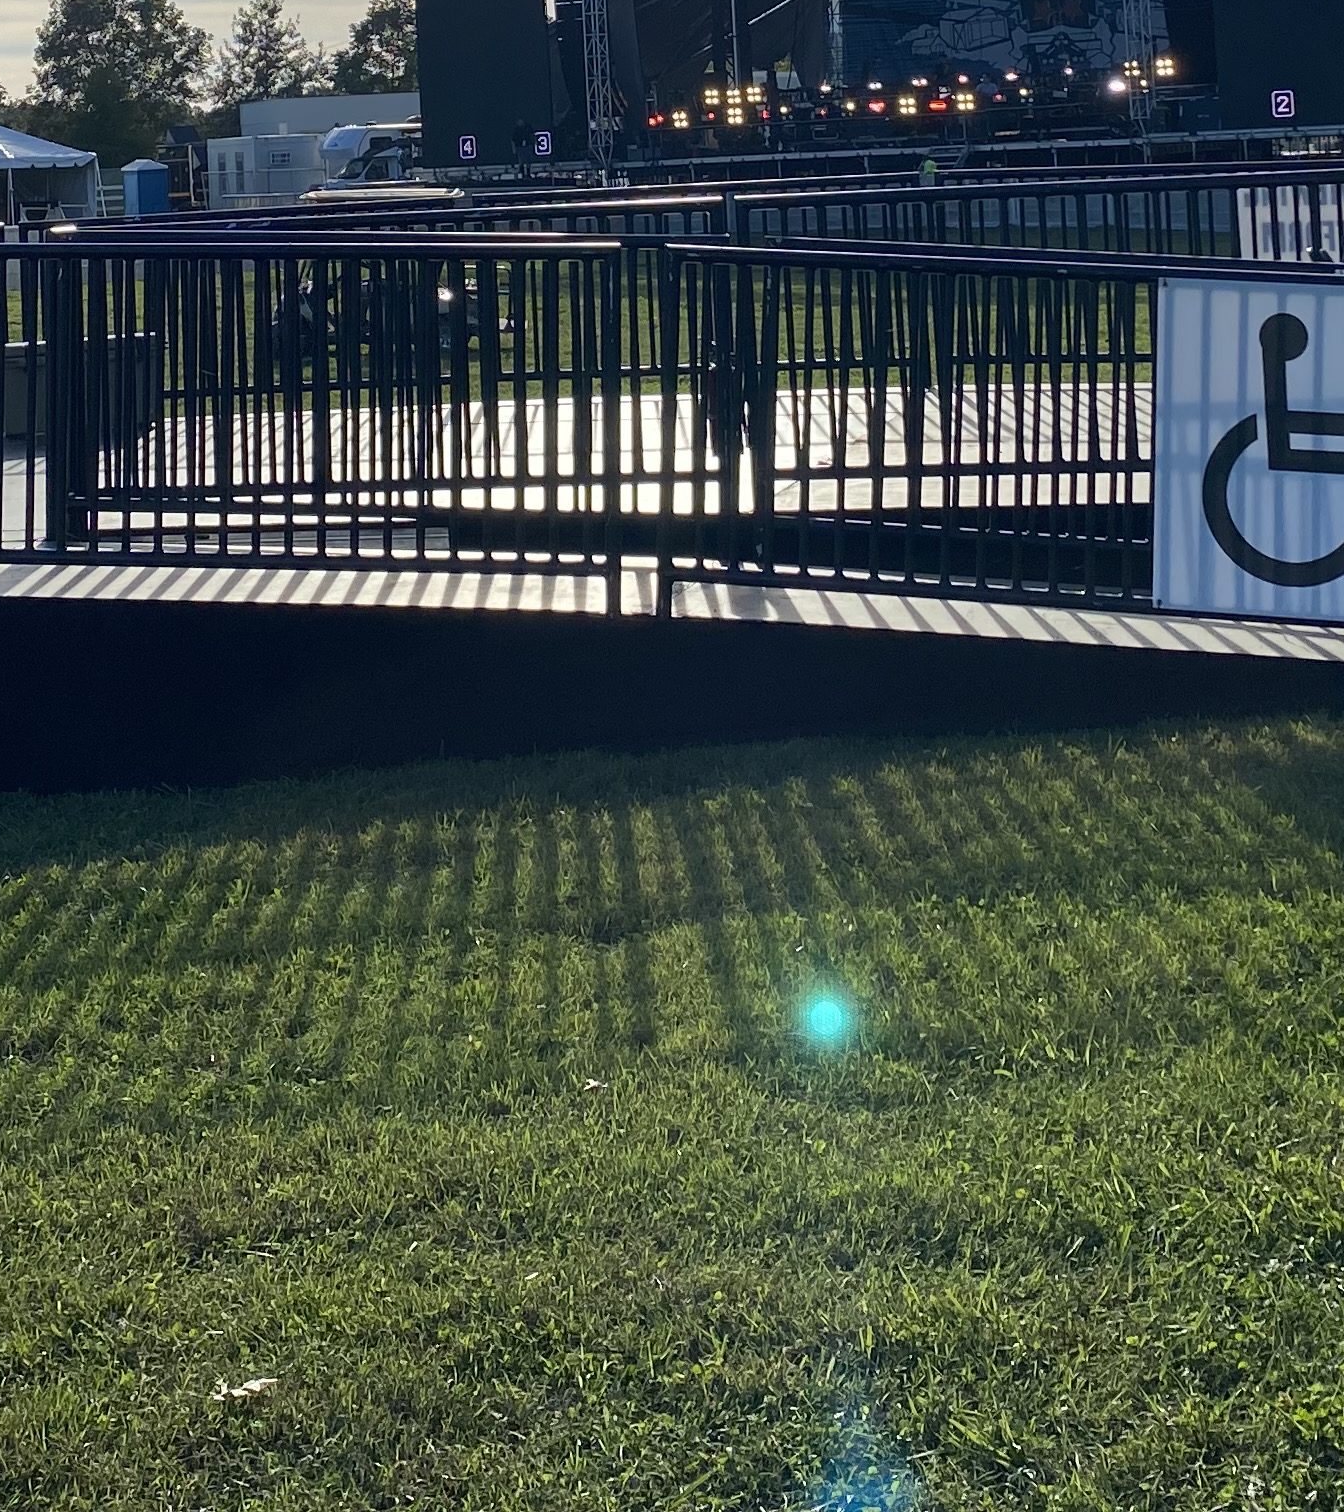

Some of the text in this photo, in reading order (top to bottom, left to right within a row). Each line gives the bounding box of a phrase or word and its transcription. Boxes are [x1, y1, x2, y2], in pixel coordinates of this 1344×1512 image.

[1276, 95, 1290, 112] 2
[463, 140, 473, 154] 4
[537, 136, 548, 150] 3
